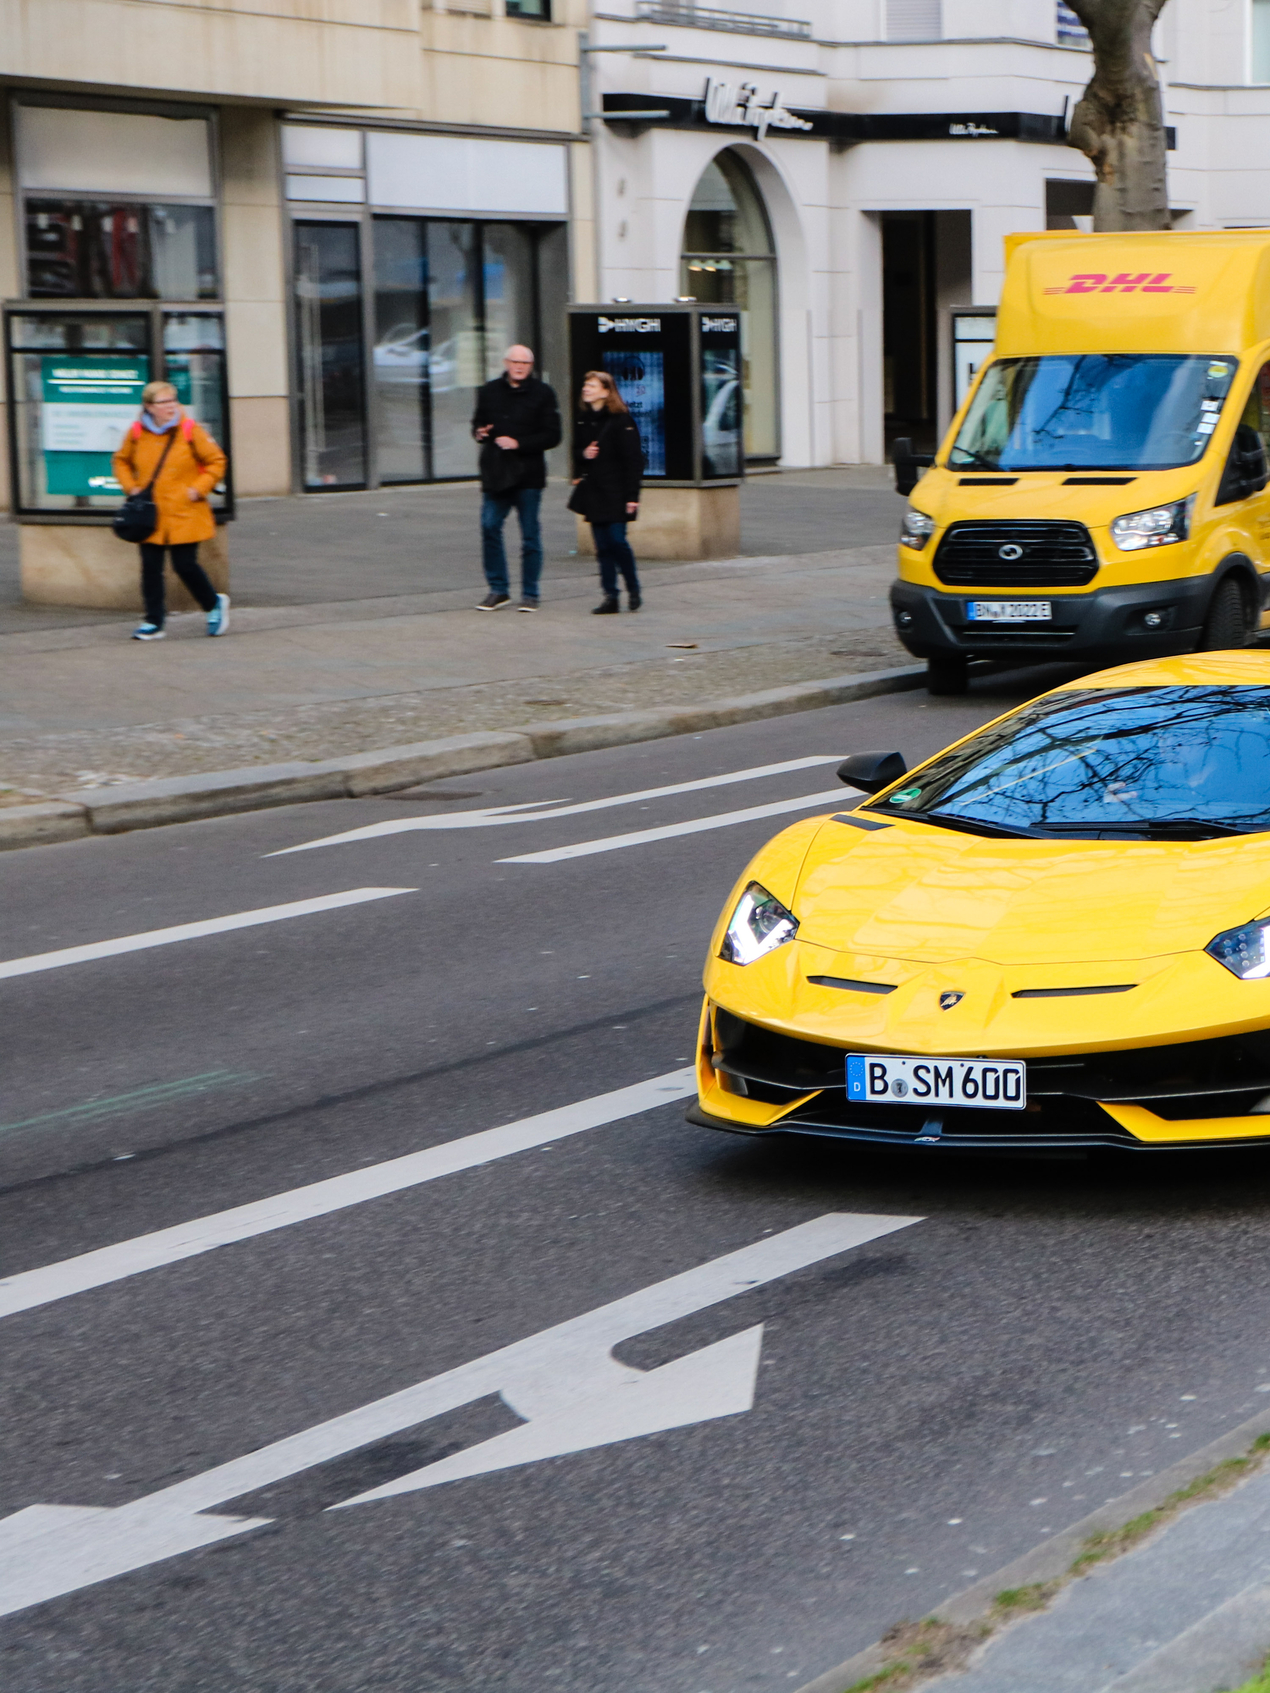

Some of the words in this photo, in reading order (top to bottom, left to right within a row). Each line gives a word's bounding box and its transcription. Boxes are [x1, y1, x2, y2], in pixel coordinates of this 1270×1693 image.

[1064, 273, 1173, 294] DHL
[853, 1082, 861, 1092] D
[869, 1062, 889, 1096] B
[912, 1064, 954, 1099] SM
[961, 1066, 1021, 1102] 600
